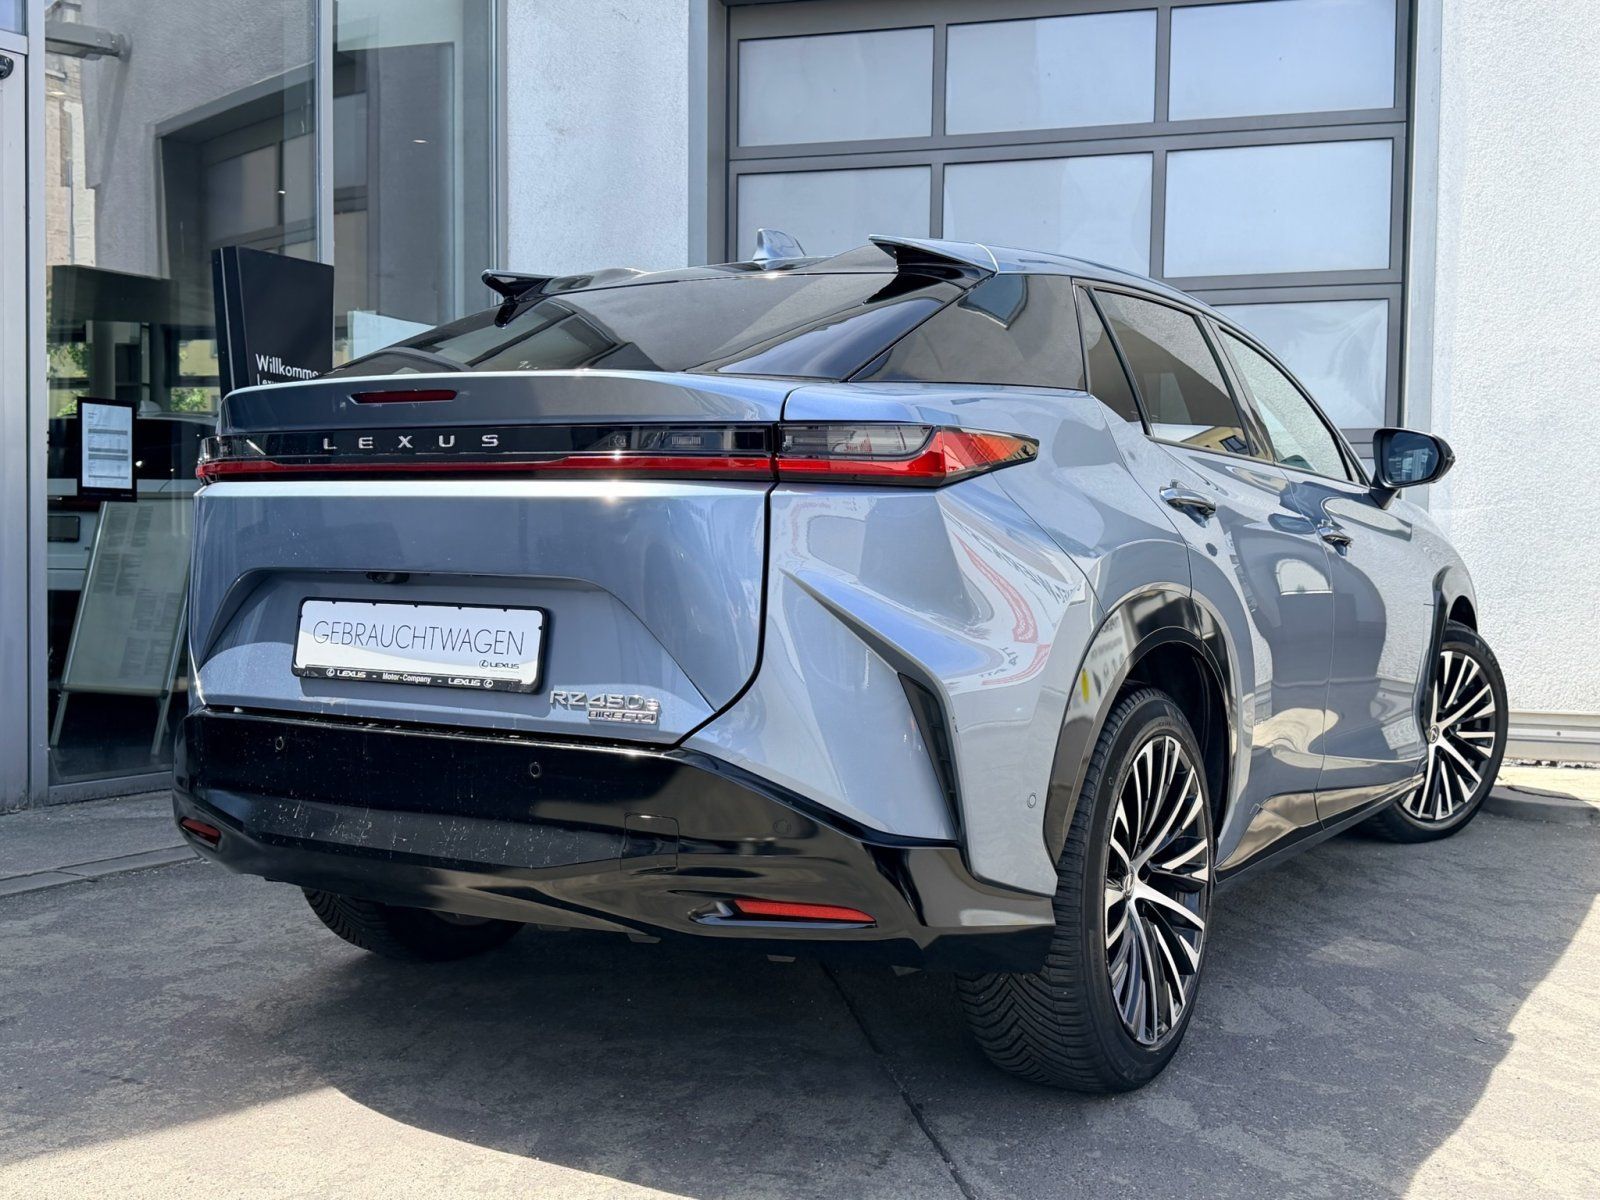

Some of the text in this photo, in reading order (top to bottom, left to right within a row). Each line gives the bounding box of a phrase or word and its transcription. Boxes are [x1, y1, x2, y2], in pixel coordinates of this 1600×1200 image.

[255, 353, 320, 380] Willkomme
[323, 434, 500, 450] LEXUS
[313, 620, 525, 656] GEBRAUCHTWAGEN
[336, 670, 367, 678] LEXUS
[382, 672, 432, 684] Motor-Company
[448, 677, 480, 687] LEXUS
